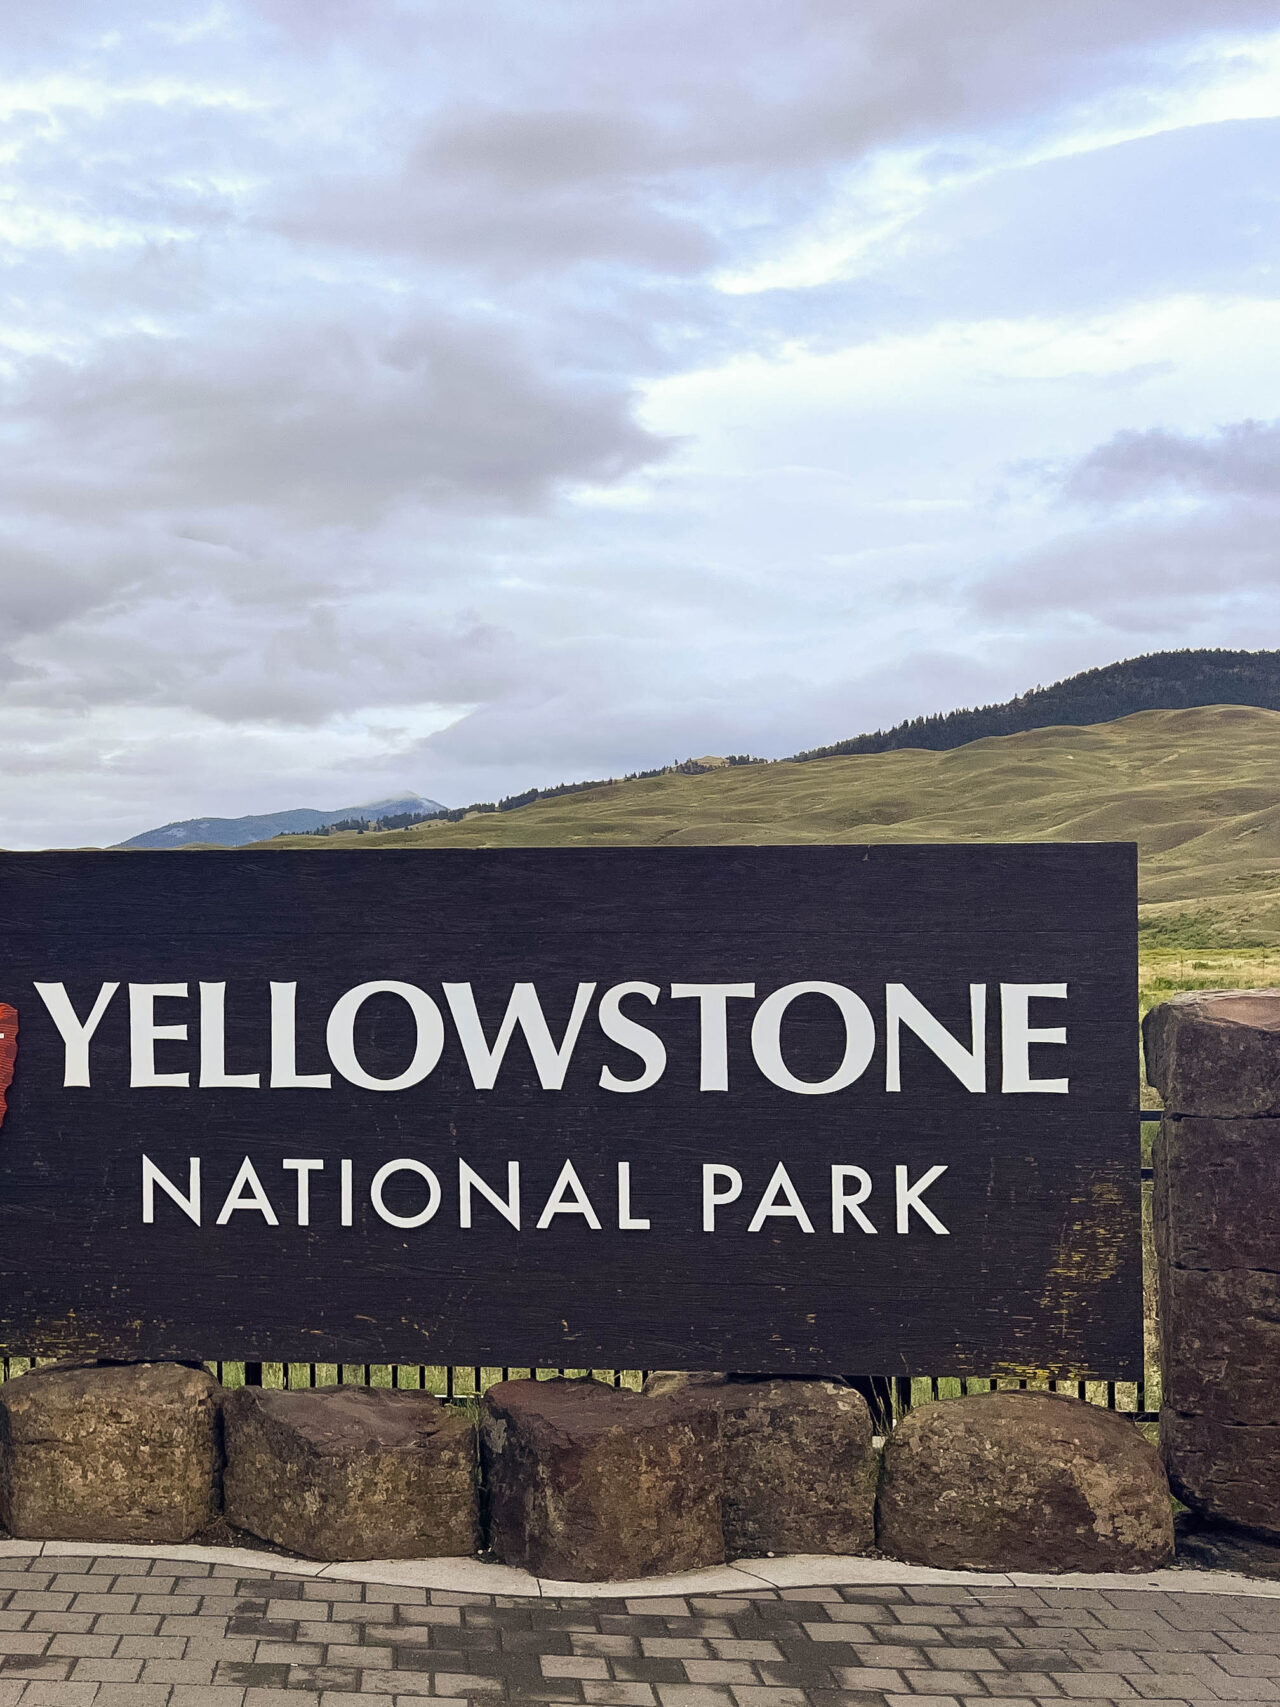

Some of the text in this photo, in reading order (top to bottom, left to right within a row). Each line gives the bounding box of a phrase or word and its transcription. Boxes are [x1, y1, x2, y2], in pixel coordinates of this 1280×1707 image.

[33, 980, 1070, 1095] YELLOWSTONE
[141, 1154, 951, 1236] NATIONAL PARK
